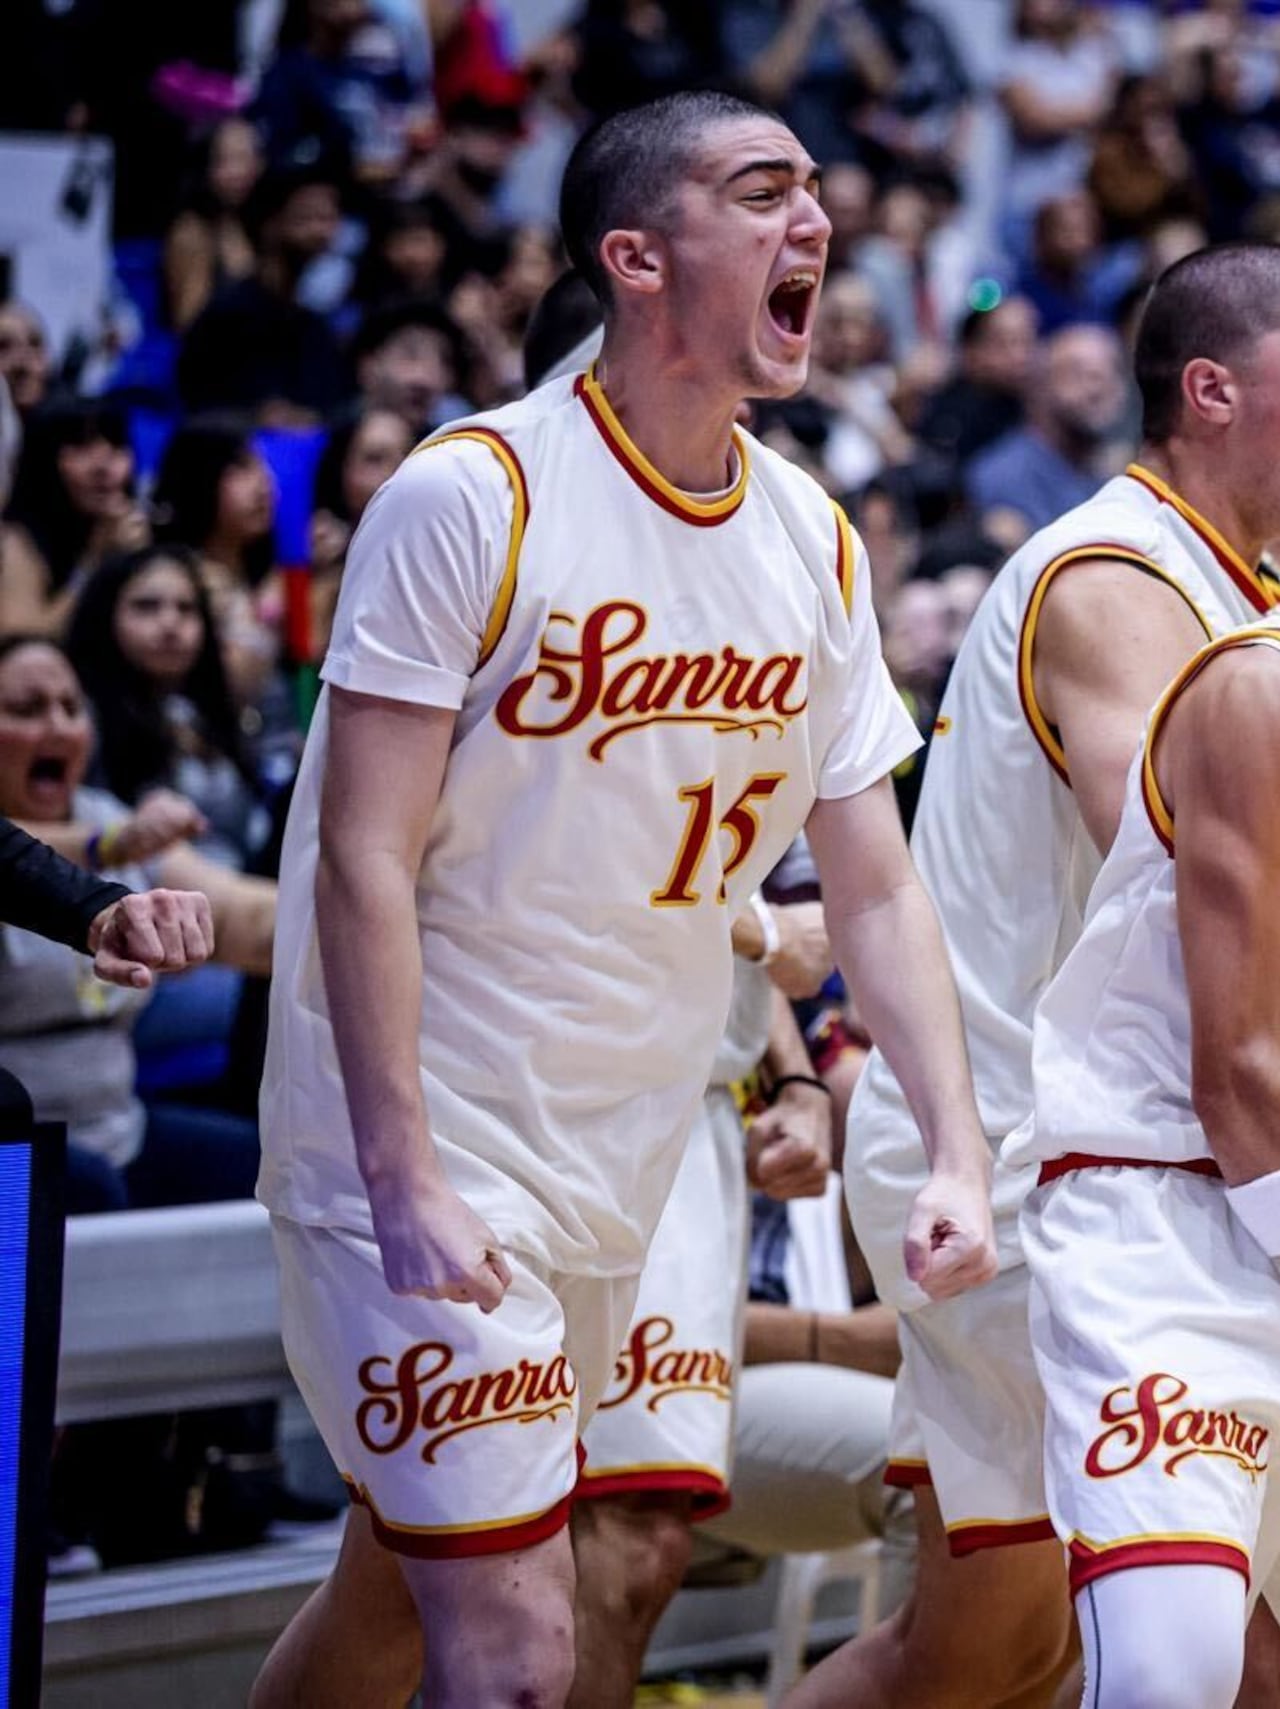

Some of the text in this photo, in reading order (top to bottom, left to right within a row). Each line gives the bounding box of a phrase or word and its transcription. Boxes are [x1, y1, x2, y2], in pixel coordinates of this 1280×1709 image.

[494, 600, 810, 738] Sanra
[649, 771, 789, 908] 15
[355, 1340, 578, 1456] Sanra
[1084, 1372, 1269, 1480] Sanra
